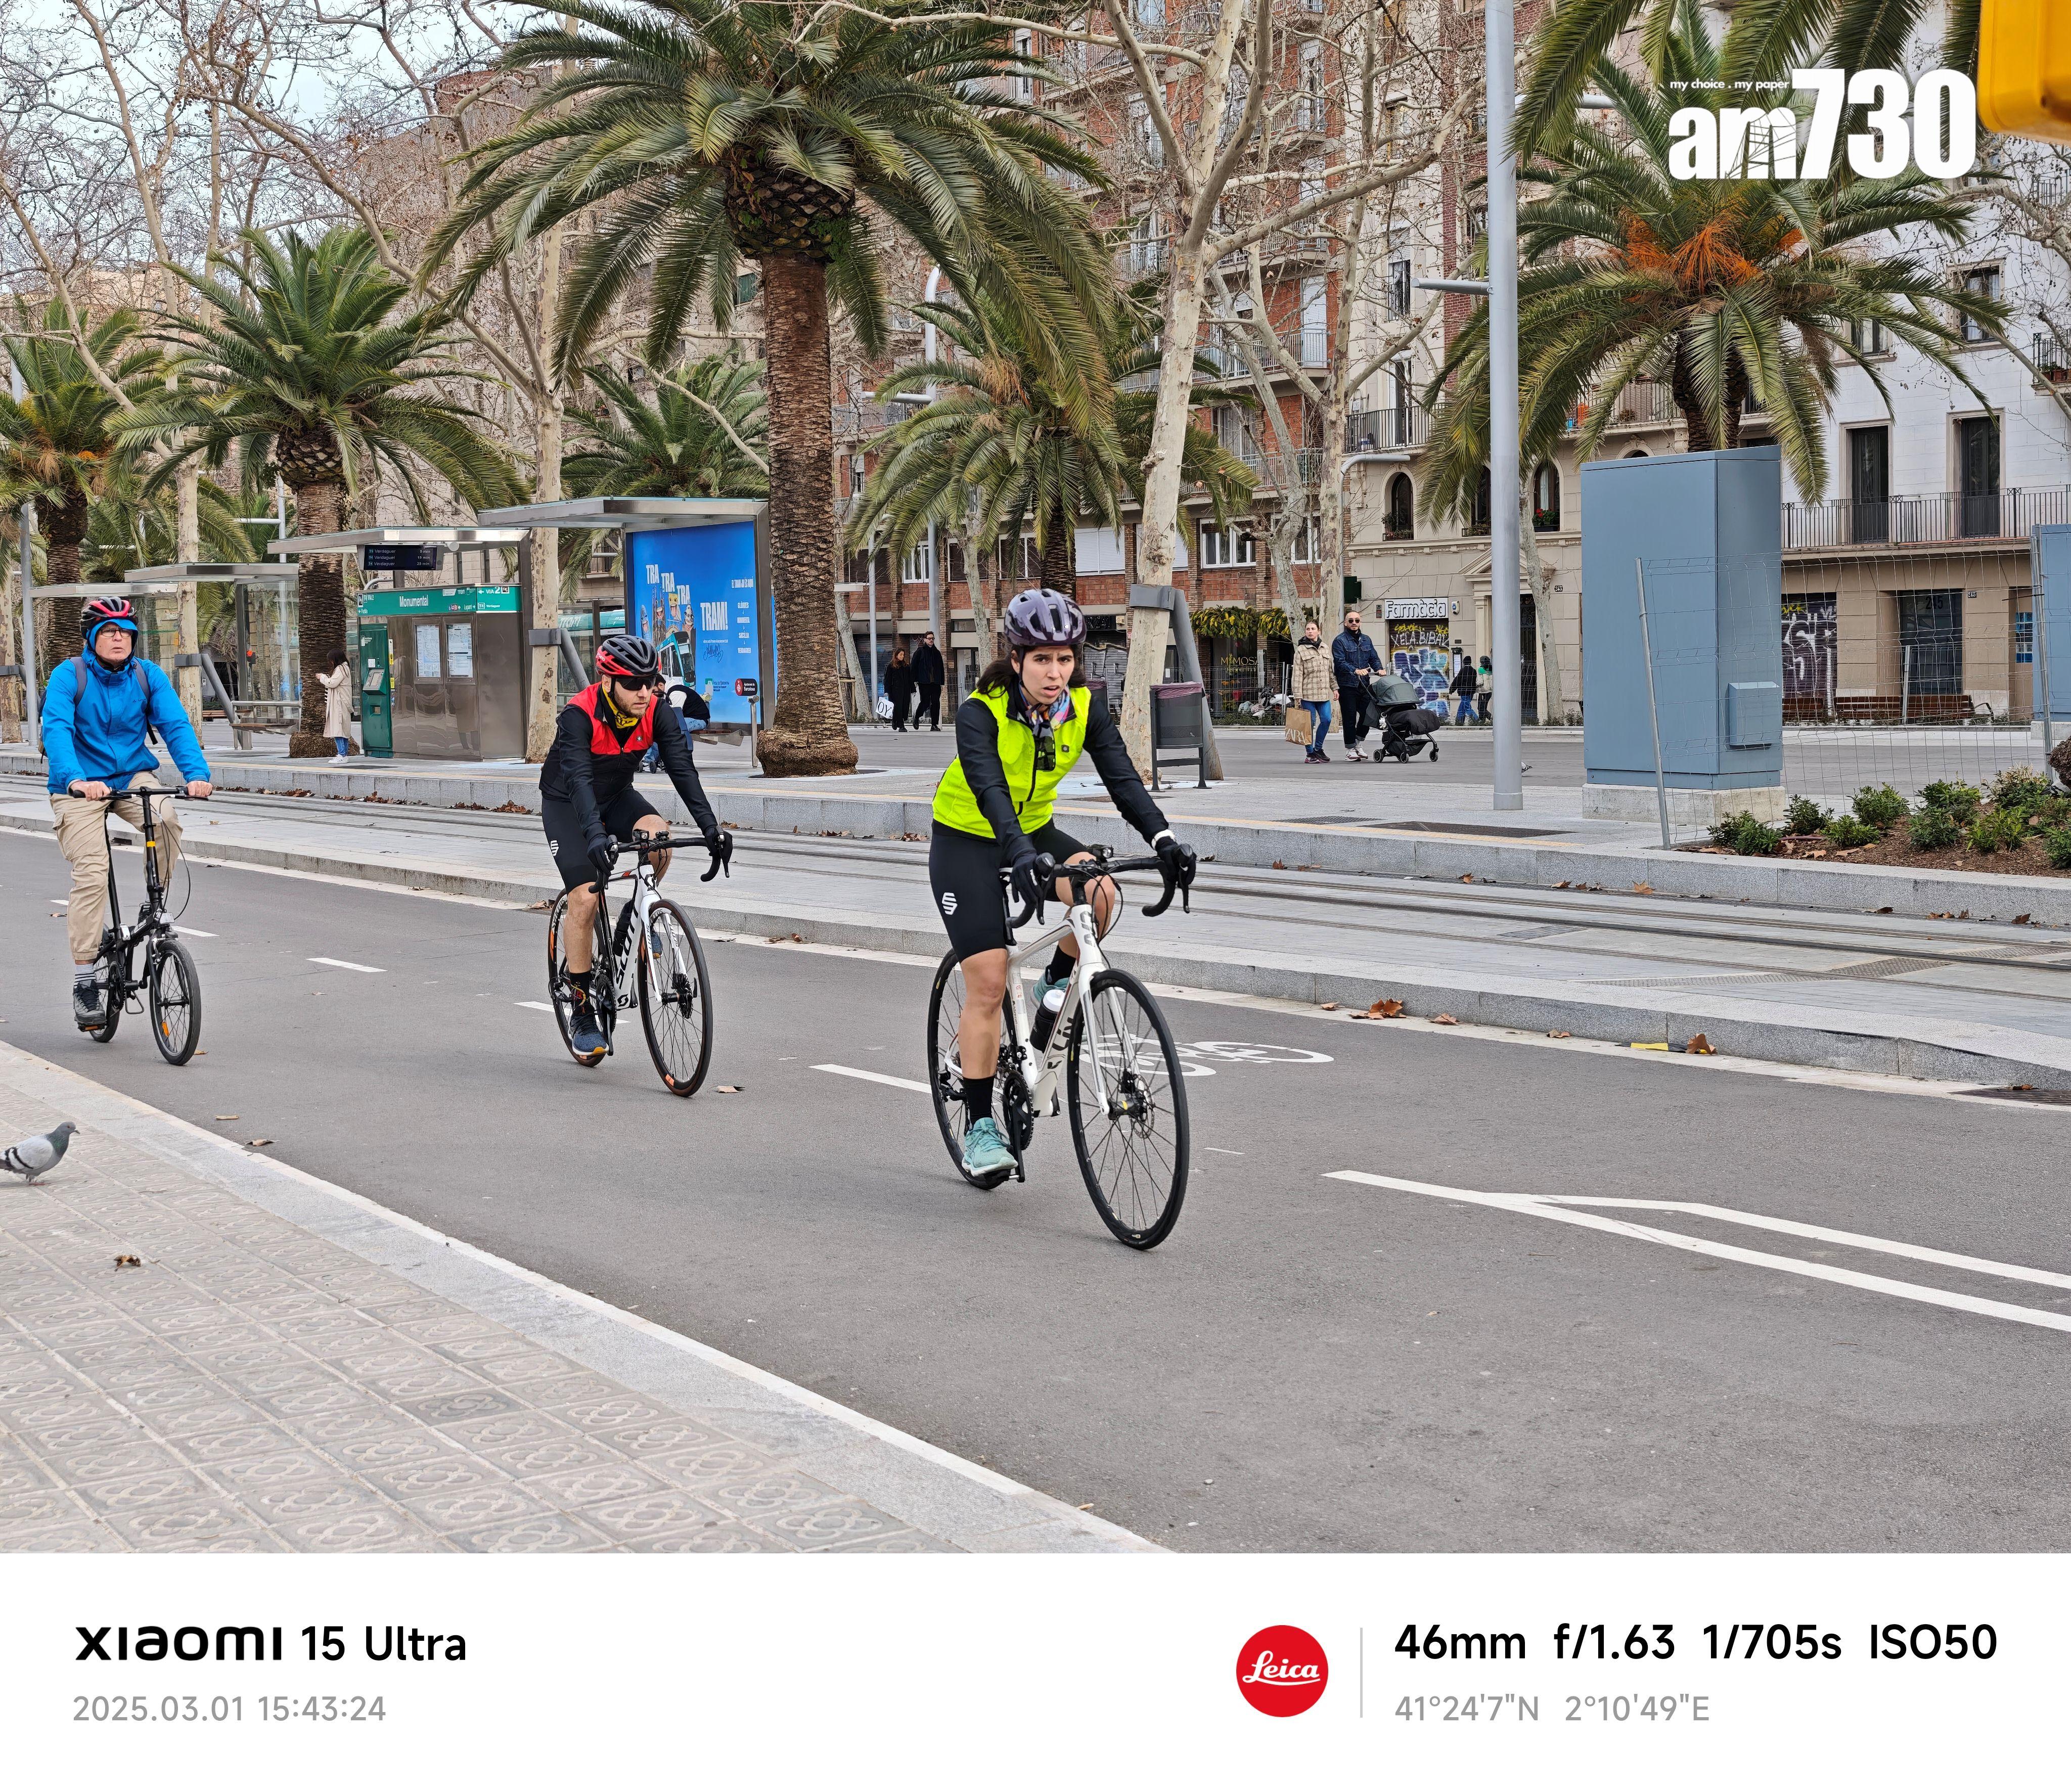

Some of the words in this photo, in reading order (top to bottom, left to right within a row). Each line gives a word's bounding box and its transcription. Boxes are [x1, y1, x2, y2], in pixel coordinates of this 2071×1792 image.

[646, 564, 659, 585] TRA
[661, 572, 676, 593] TRA
[399, 595, 429, 607] Monumental
[676, 585, 691, 605] TRA
[700, 601, 729, 631] TRAM!
[1386, 599, 1447, 618] Farmàcia
[1221, 656, 1257, 665] MMOS
[878, 701, 892, 718] OY
